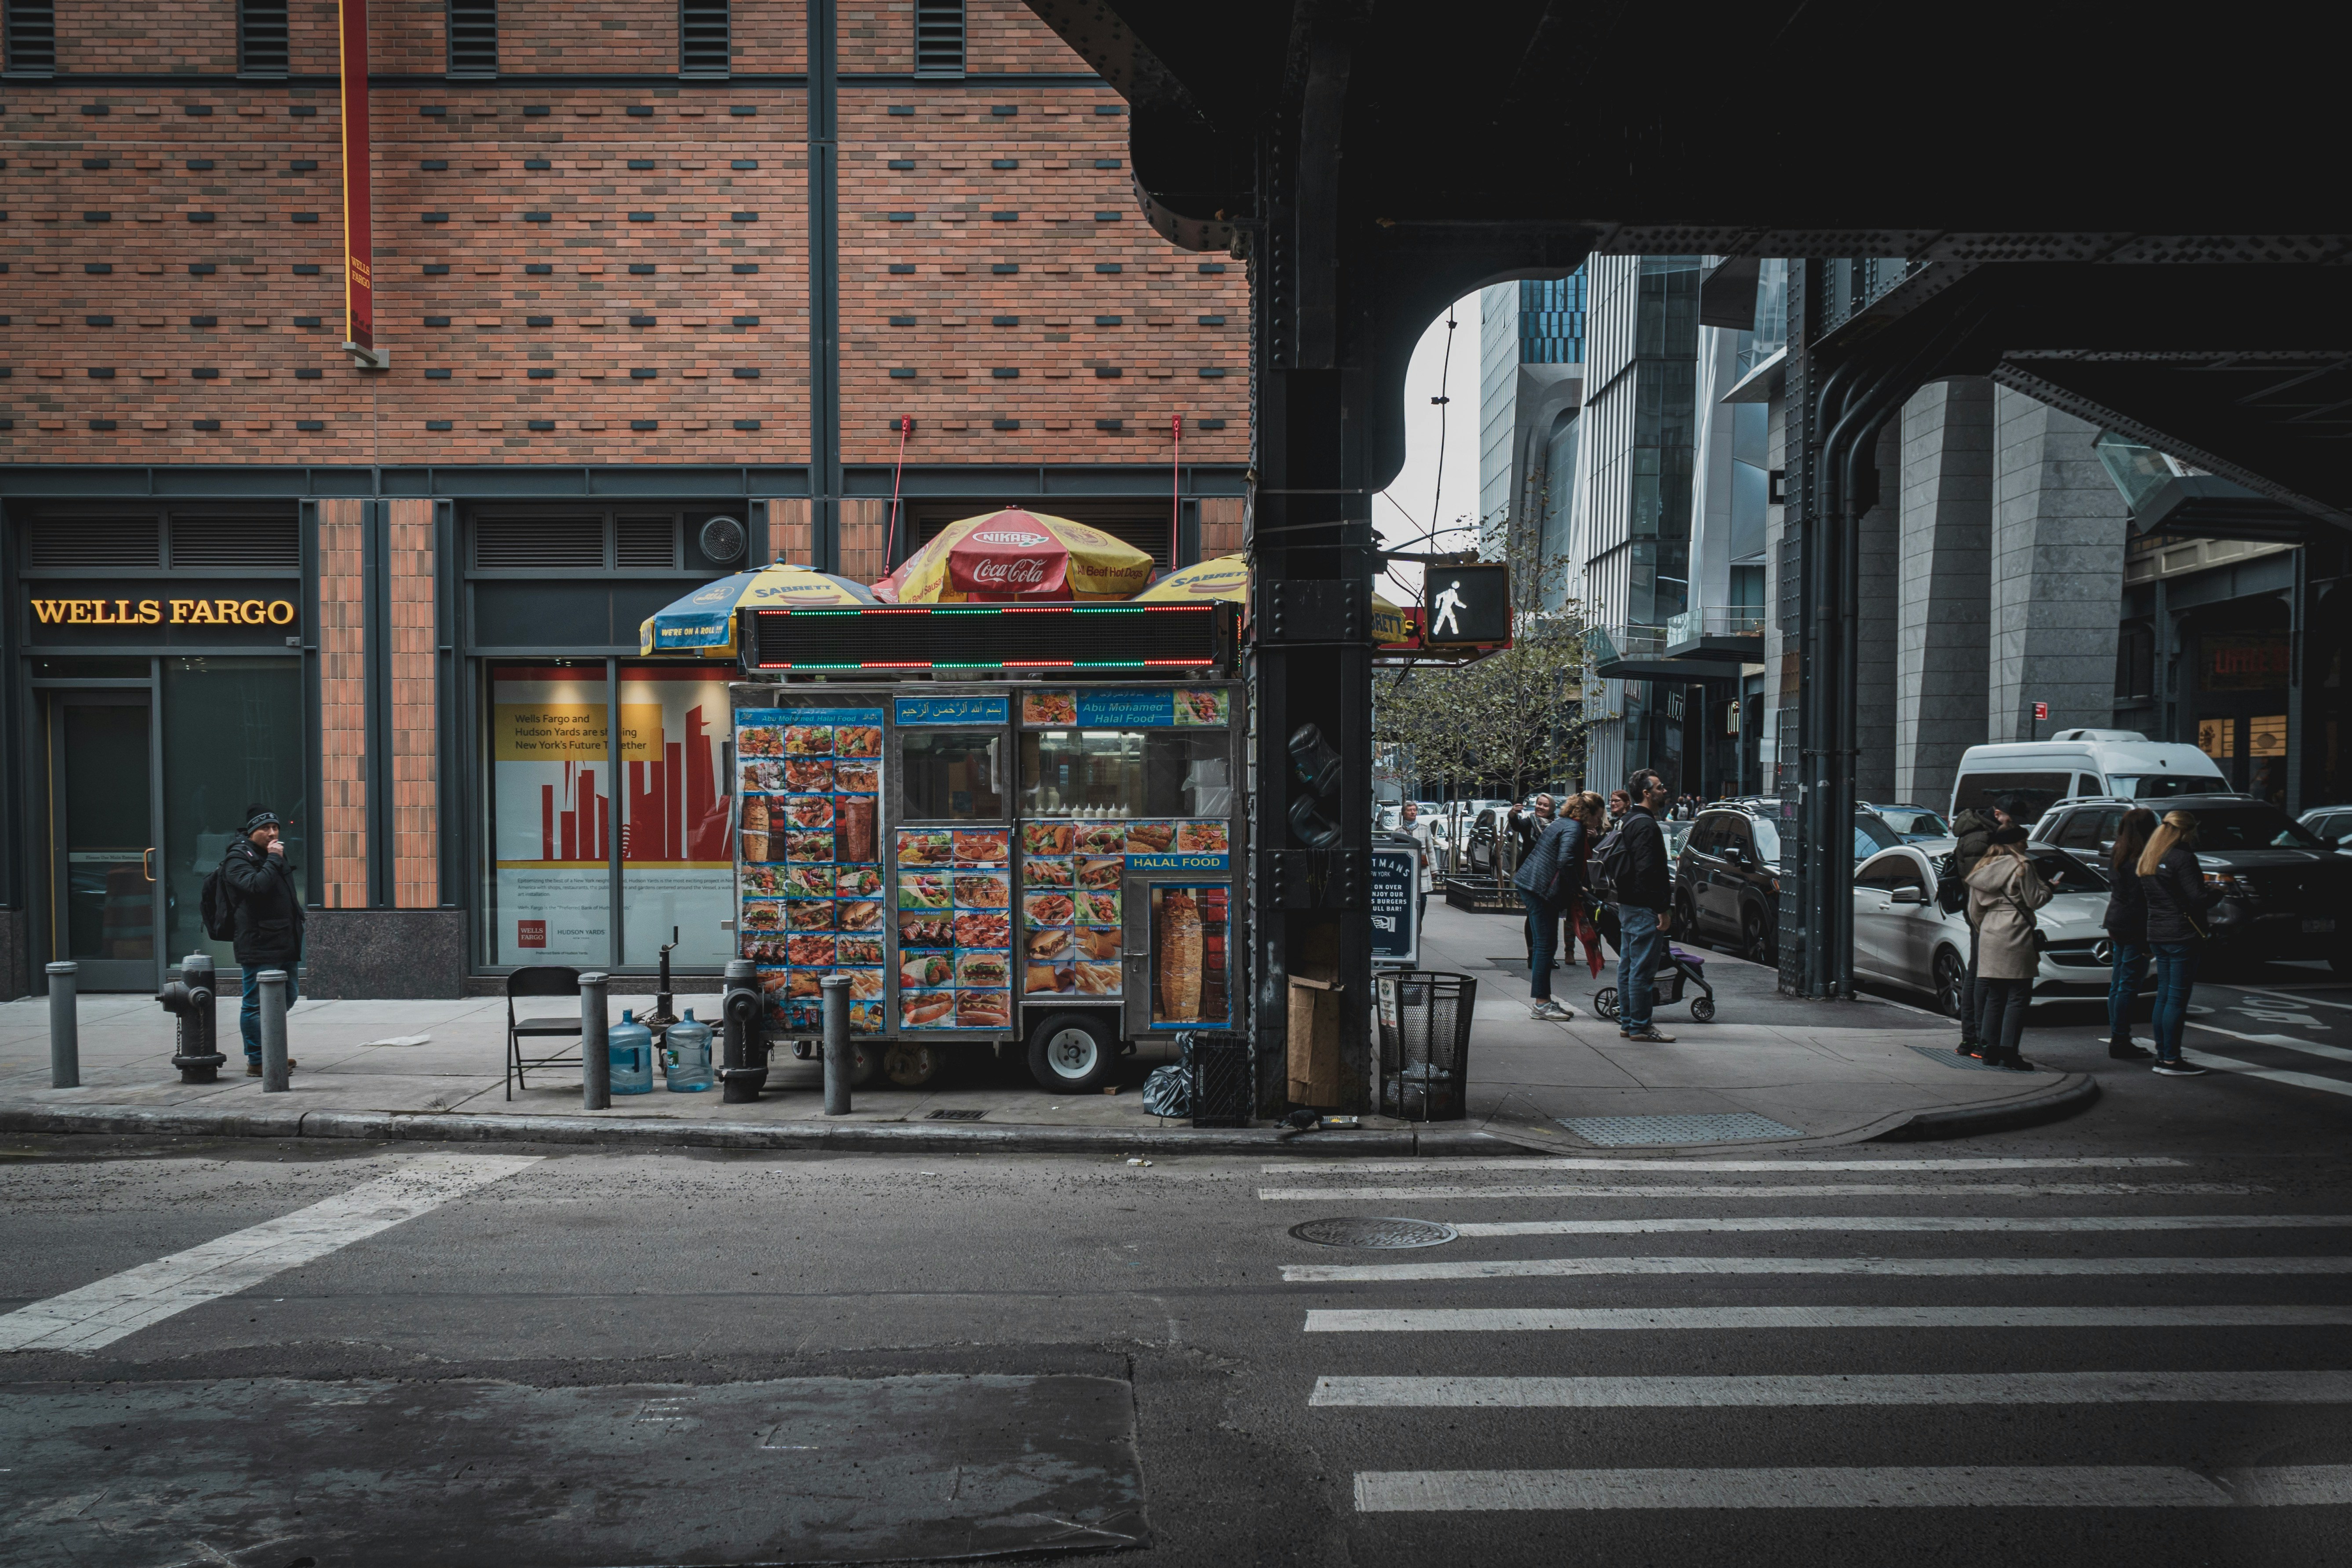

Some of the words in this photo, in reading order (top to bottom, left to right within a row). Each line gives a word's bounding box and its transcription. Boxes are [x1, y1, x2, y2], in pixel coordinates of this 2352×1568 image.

[351, 255, 370, 276] WELLS
[352, 269, 370, 289] FARGO
[983, 533, 1032, 542] NIKAS
[973, 559, 1047, 582] Coca-Cola
[1086, 566, 1108, 577] Beef
[1110, 567, 1124, 577] Hot
[1124, 568, 1143, 579] Dogs
[754, 585, 831, 597] SABRETT
[924, 576, 943, 594] Sausa
[31, 600, 161, 624] WELLS
[169, 600, 295, 625] FARGO
[1372, 612, 1402, 634] RETT
[1109, 703, 1163, 712] Mohamed
[543, 715, 570, 725] Fargo
[1095, 714, 1123, 723] Halal
[1125, 714, 1154, 723] Food
[600, 728, 637, 739] shing
[1134, 858, 1177, 867] HALAL
[1182, 858, 1220, 867] FOOD
[1372, 859, 1410, 877] TMANS
